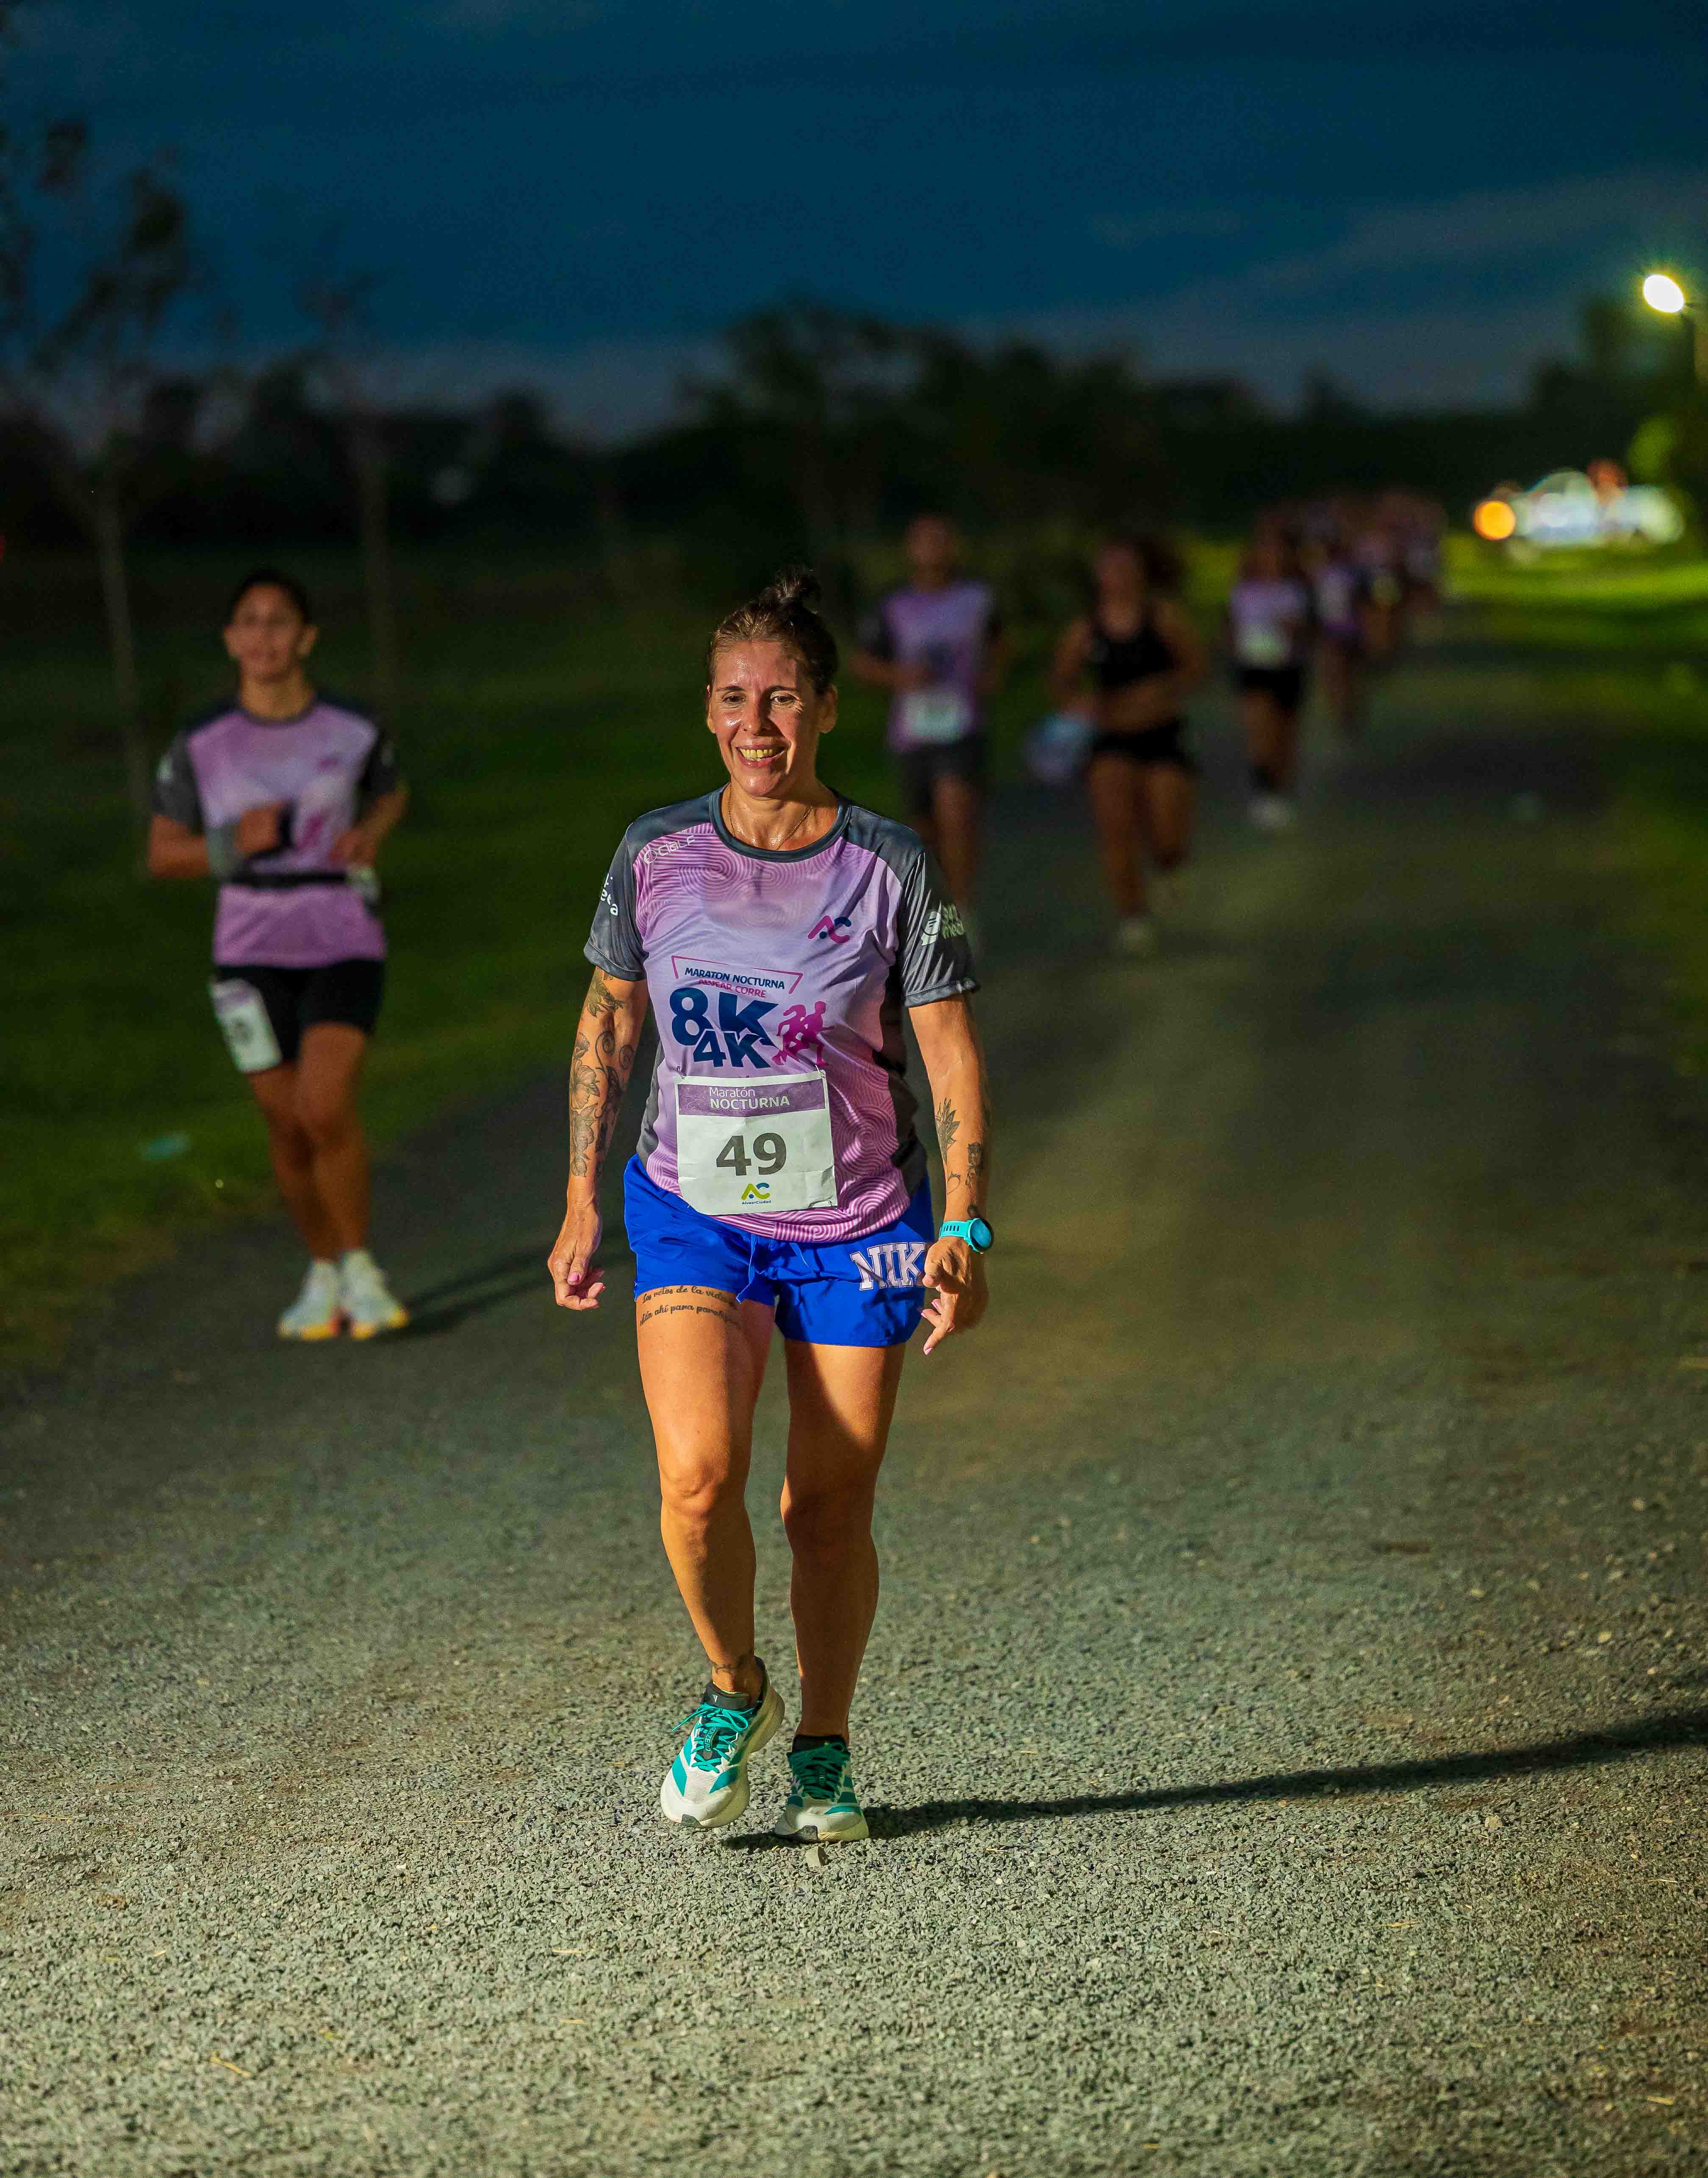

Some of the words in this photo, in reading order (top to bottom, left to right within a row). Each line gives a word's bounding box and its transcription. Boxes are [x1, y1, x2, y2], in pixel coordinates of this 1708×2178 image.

[685, 967, 730, 981] MARATON
[732, 974, 785, 990] NOCTURNA
[735, 985, 766, 998] CORRE
[669, 987, 780, 1050] 8K
[693, 1030, 771, 1069] 4K
[709, 1087, 755, 1098] Maratón
[710, 1096, 790, 1110] NOCTURNA
[716, 1132, 787, 1176] 49
[850, 1242, 926, 1290] NIK
[691, 1285, 704, 1295] la
